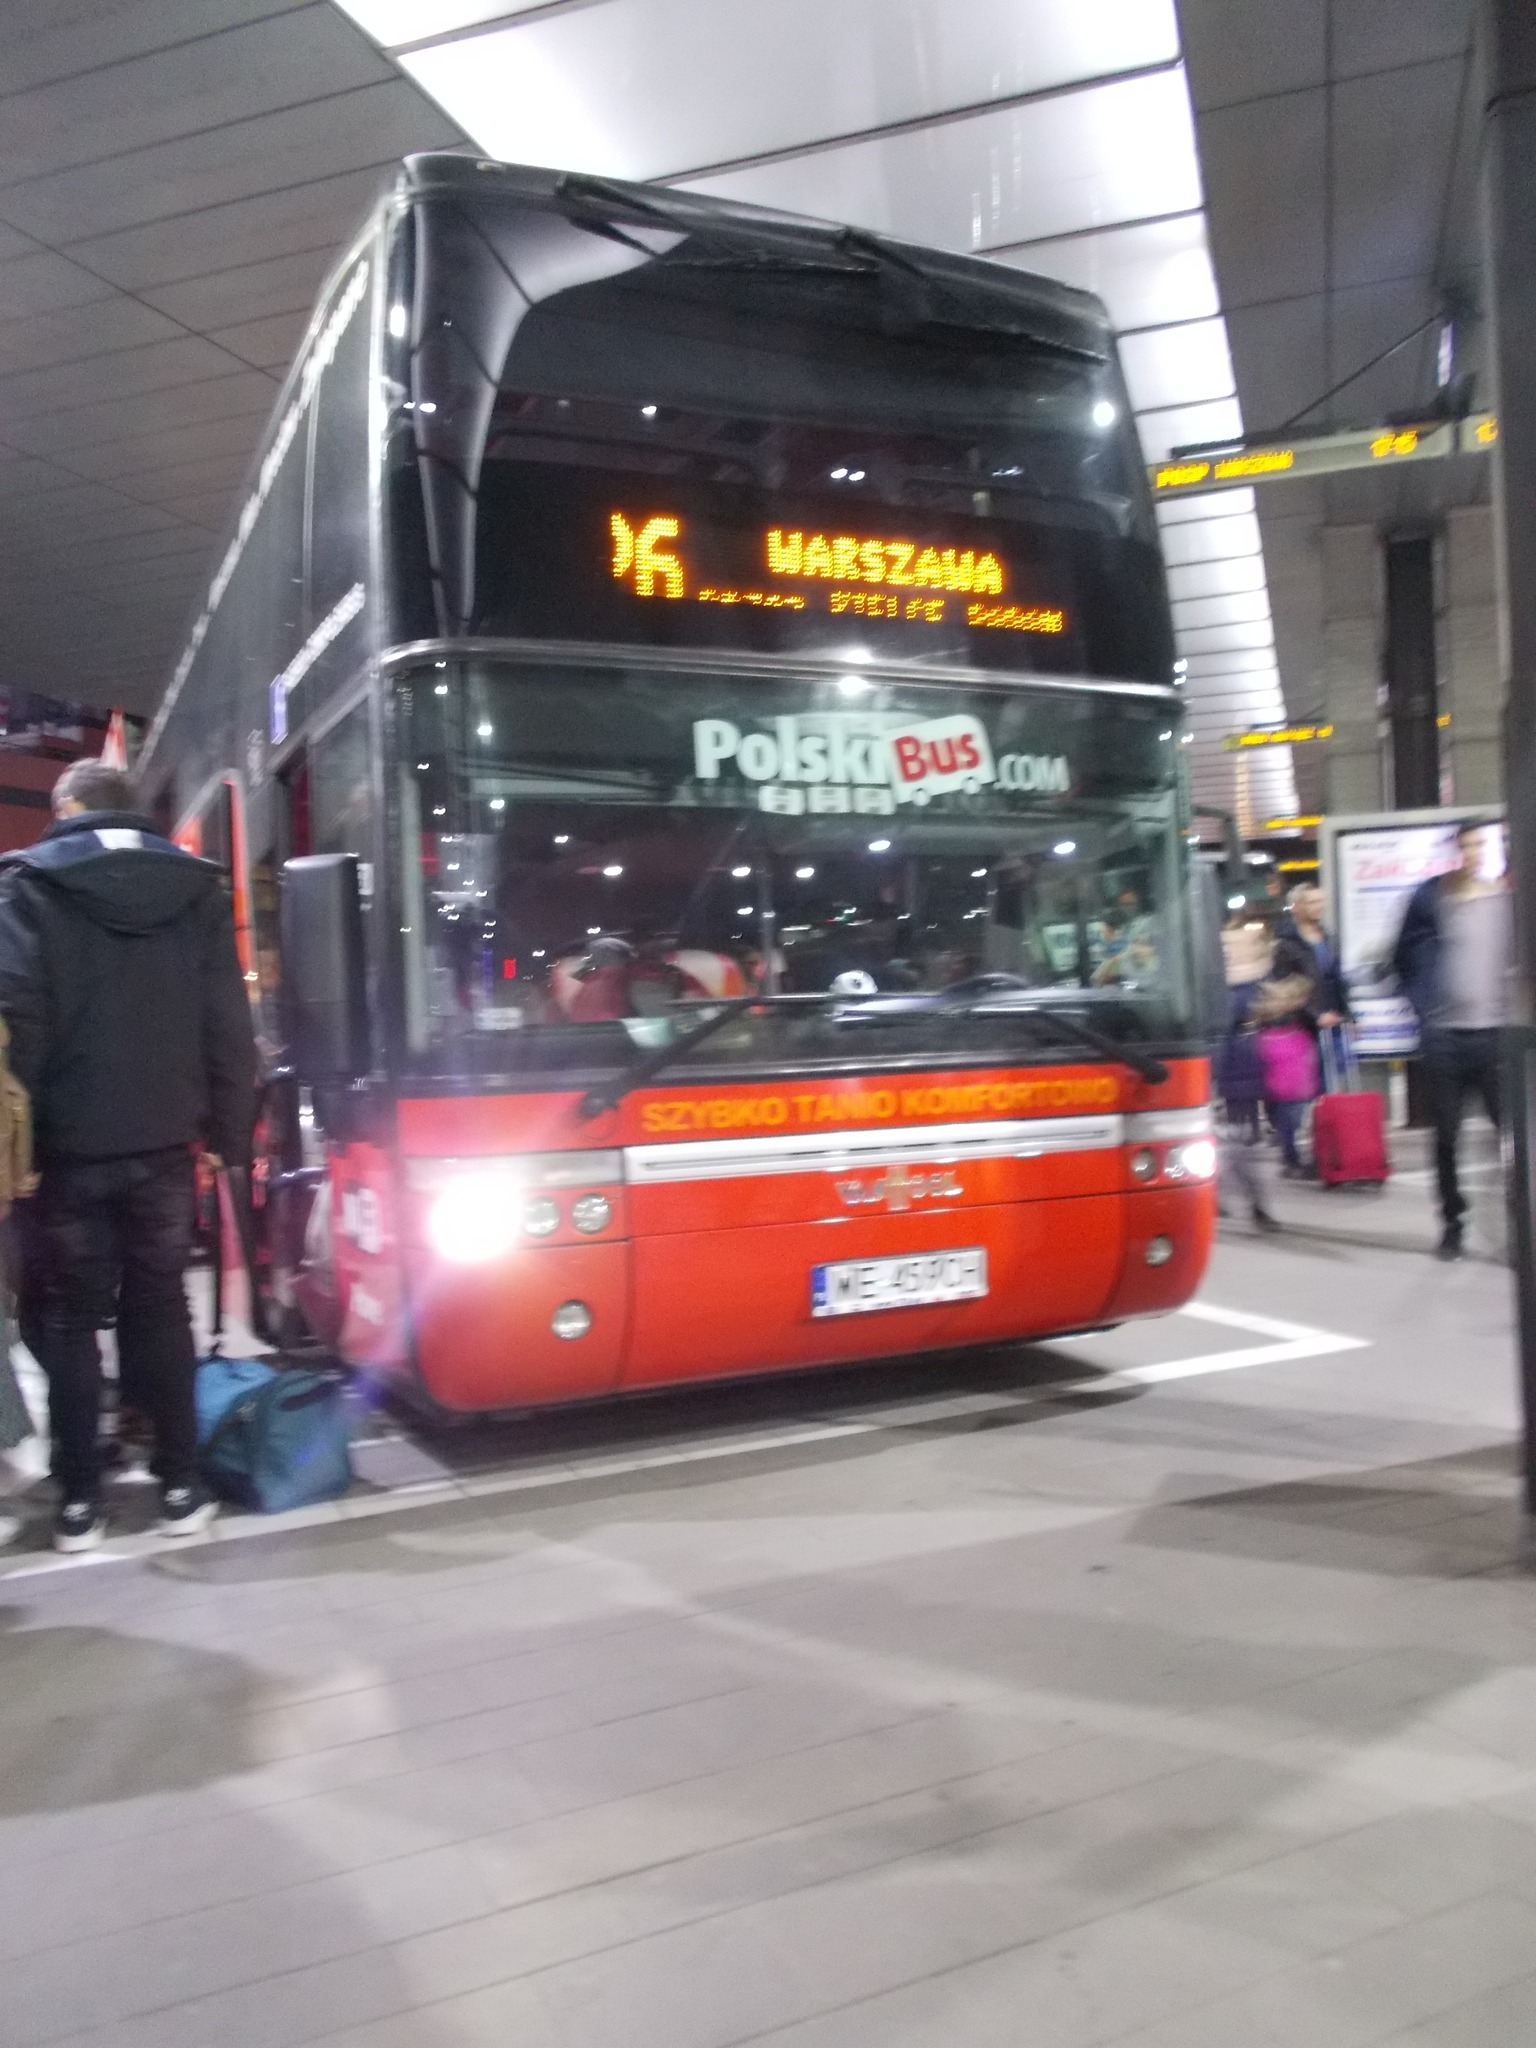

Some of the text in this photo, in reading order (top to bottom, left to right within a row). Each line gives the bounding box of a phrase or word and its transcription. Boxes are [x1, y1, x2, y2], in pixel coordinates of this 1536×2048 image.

[767, 528, 1003, 595] WARSZAWA
[642, 1096, 790, 1132] SZYBKO
[792, 1089, 898, 1123] TANIO
